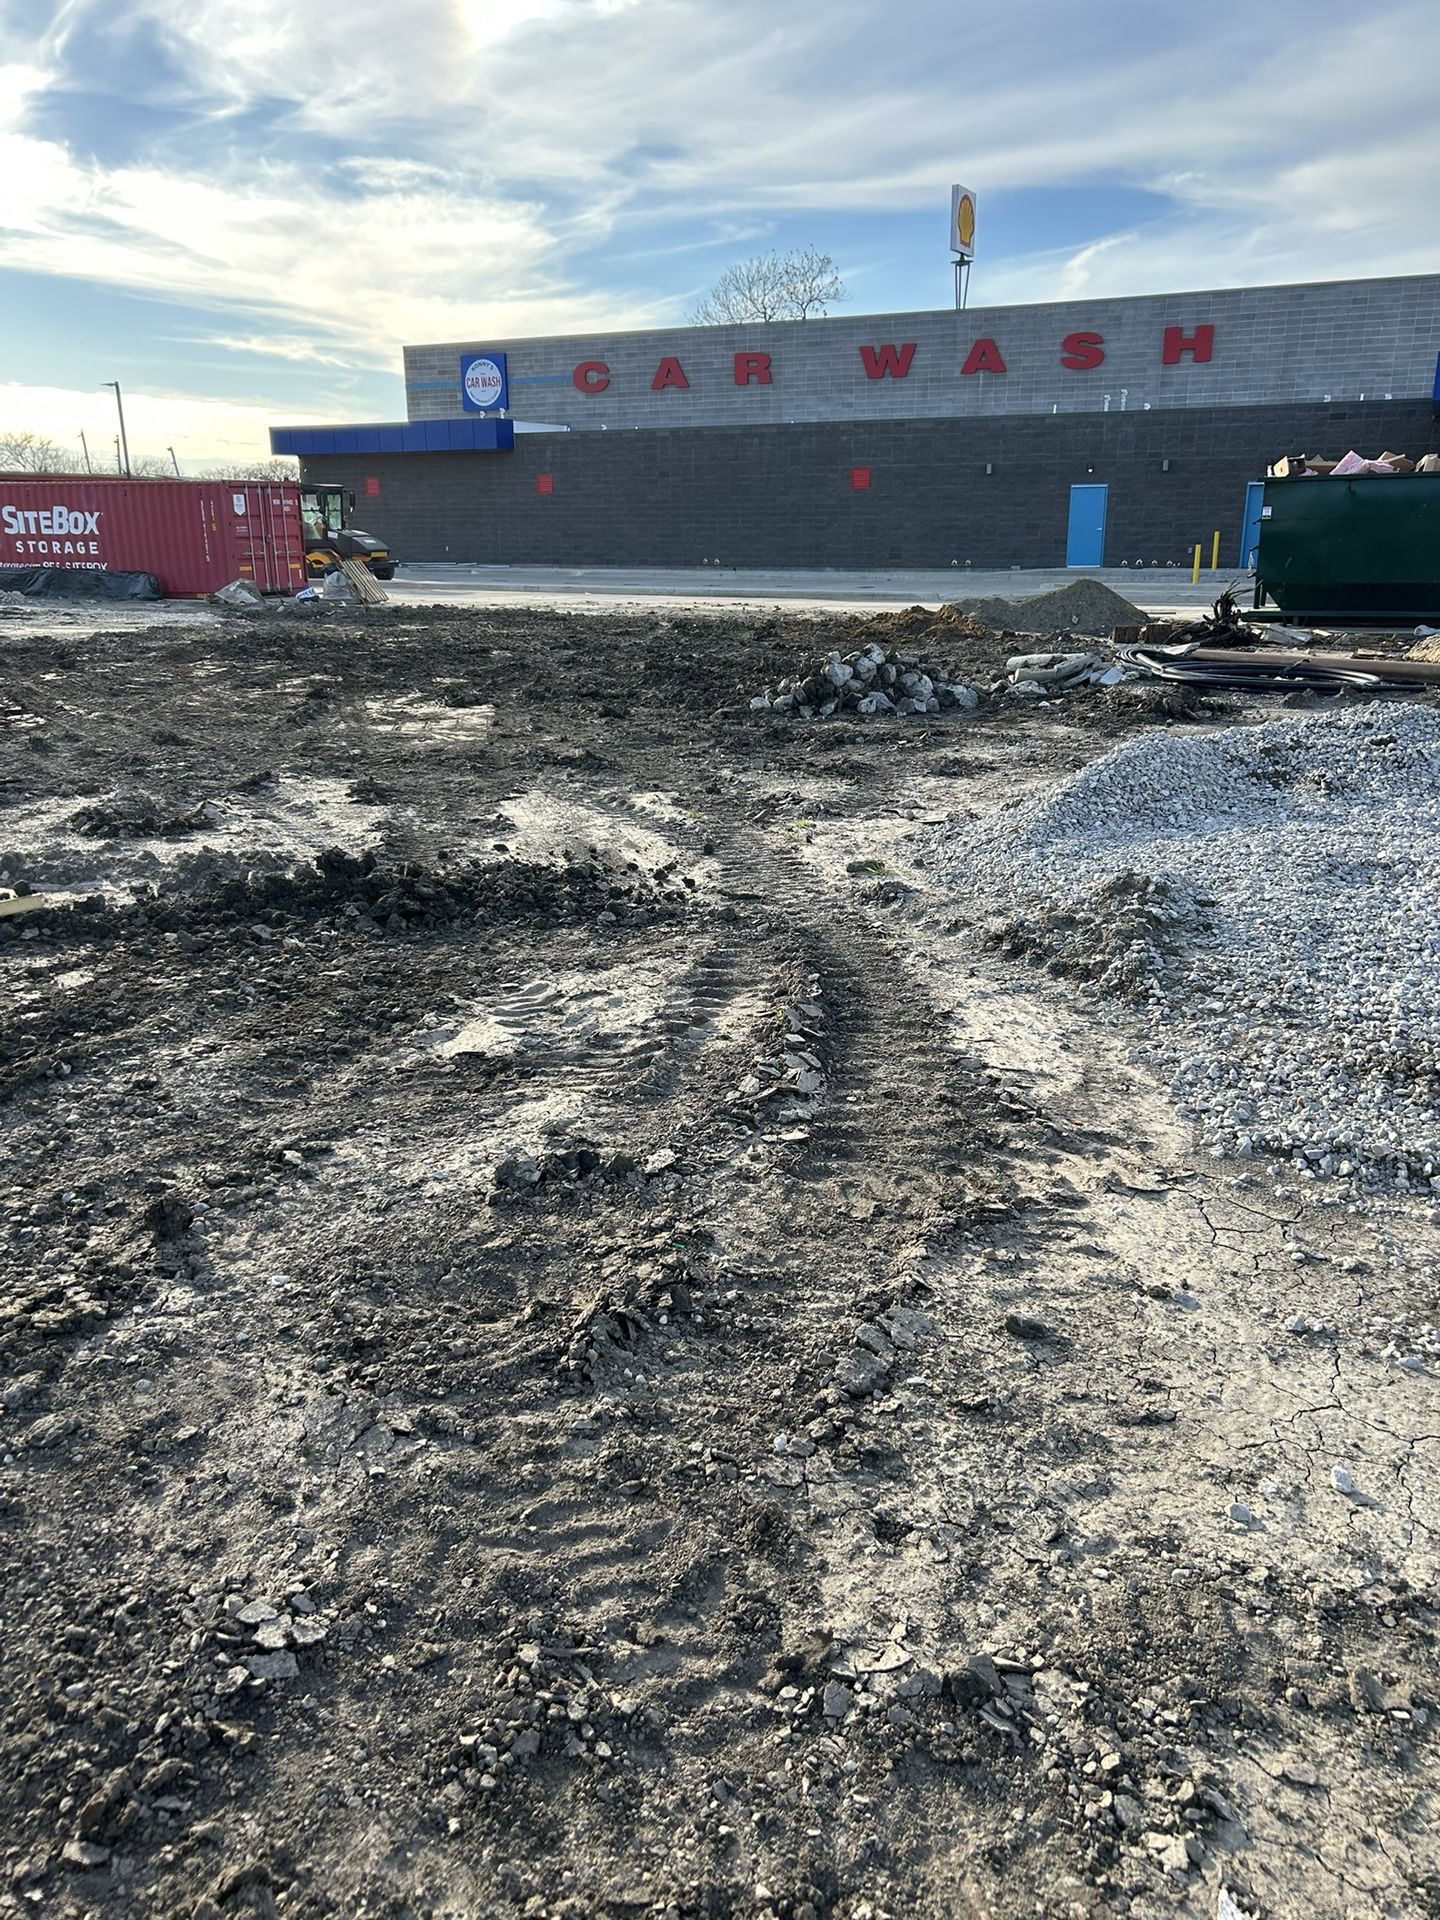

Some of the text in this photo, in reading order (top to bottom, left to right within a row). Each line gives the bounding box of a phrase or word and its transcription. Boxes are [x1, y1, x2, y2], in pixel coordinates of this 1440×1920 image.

[573, 324, 1215, 393] CAR WASH
[466, 376, 501, 388] CAR WASH
[16, 540, 99, 554] STORAGE
